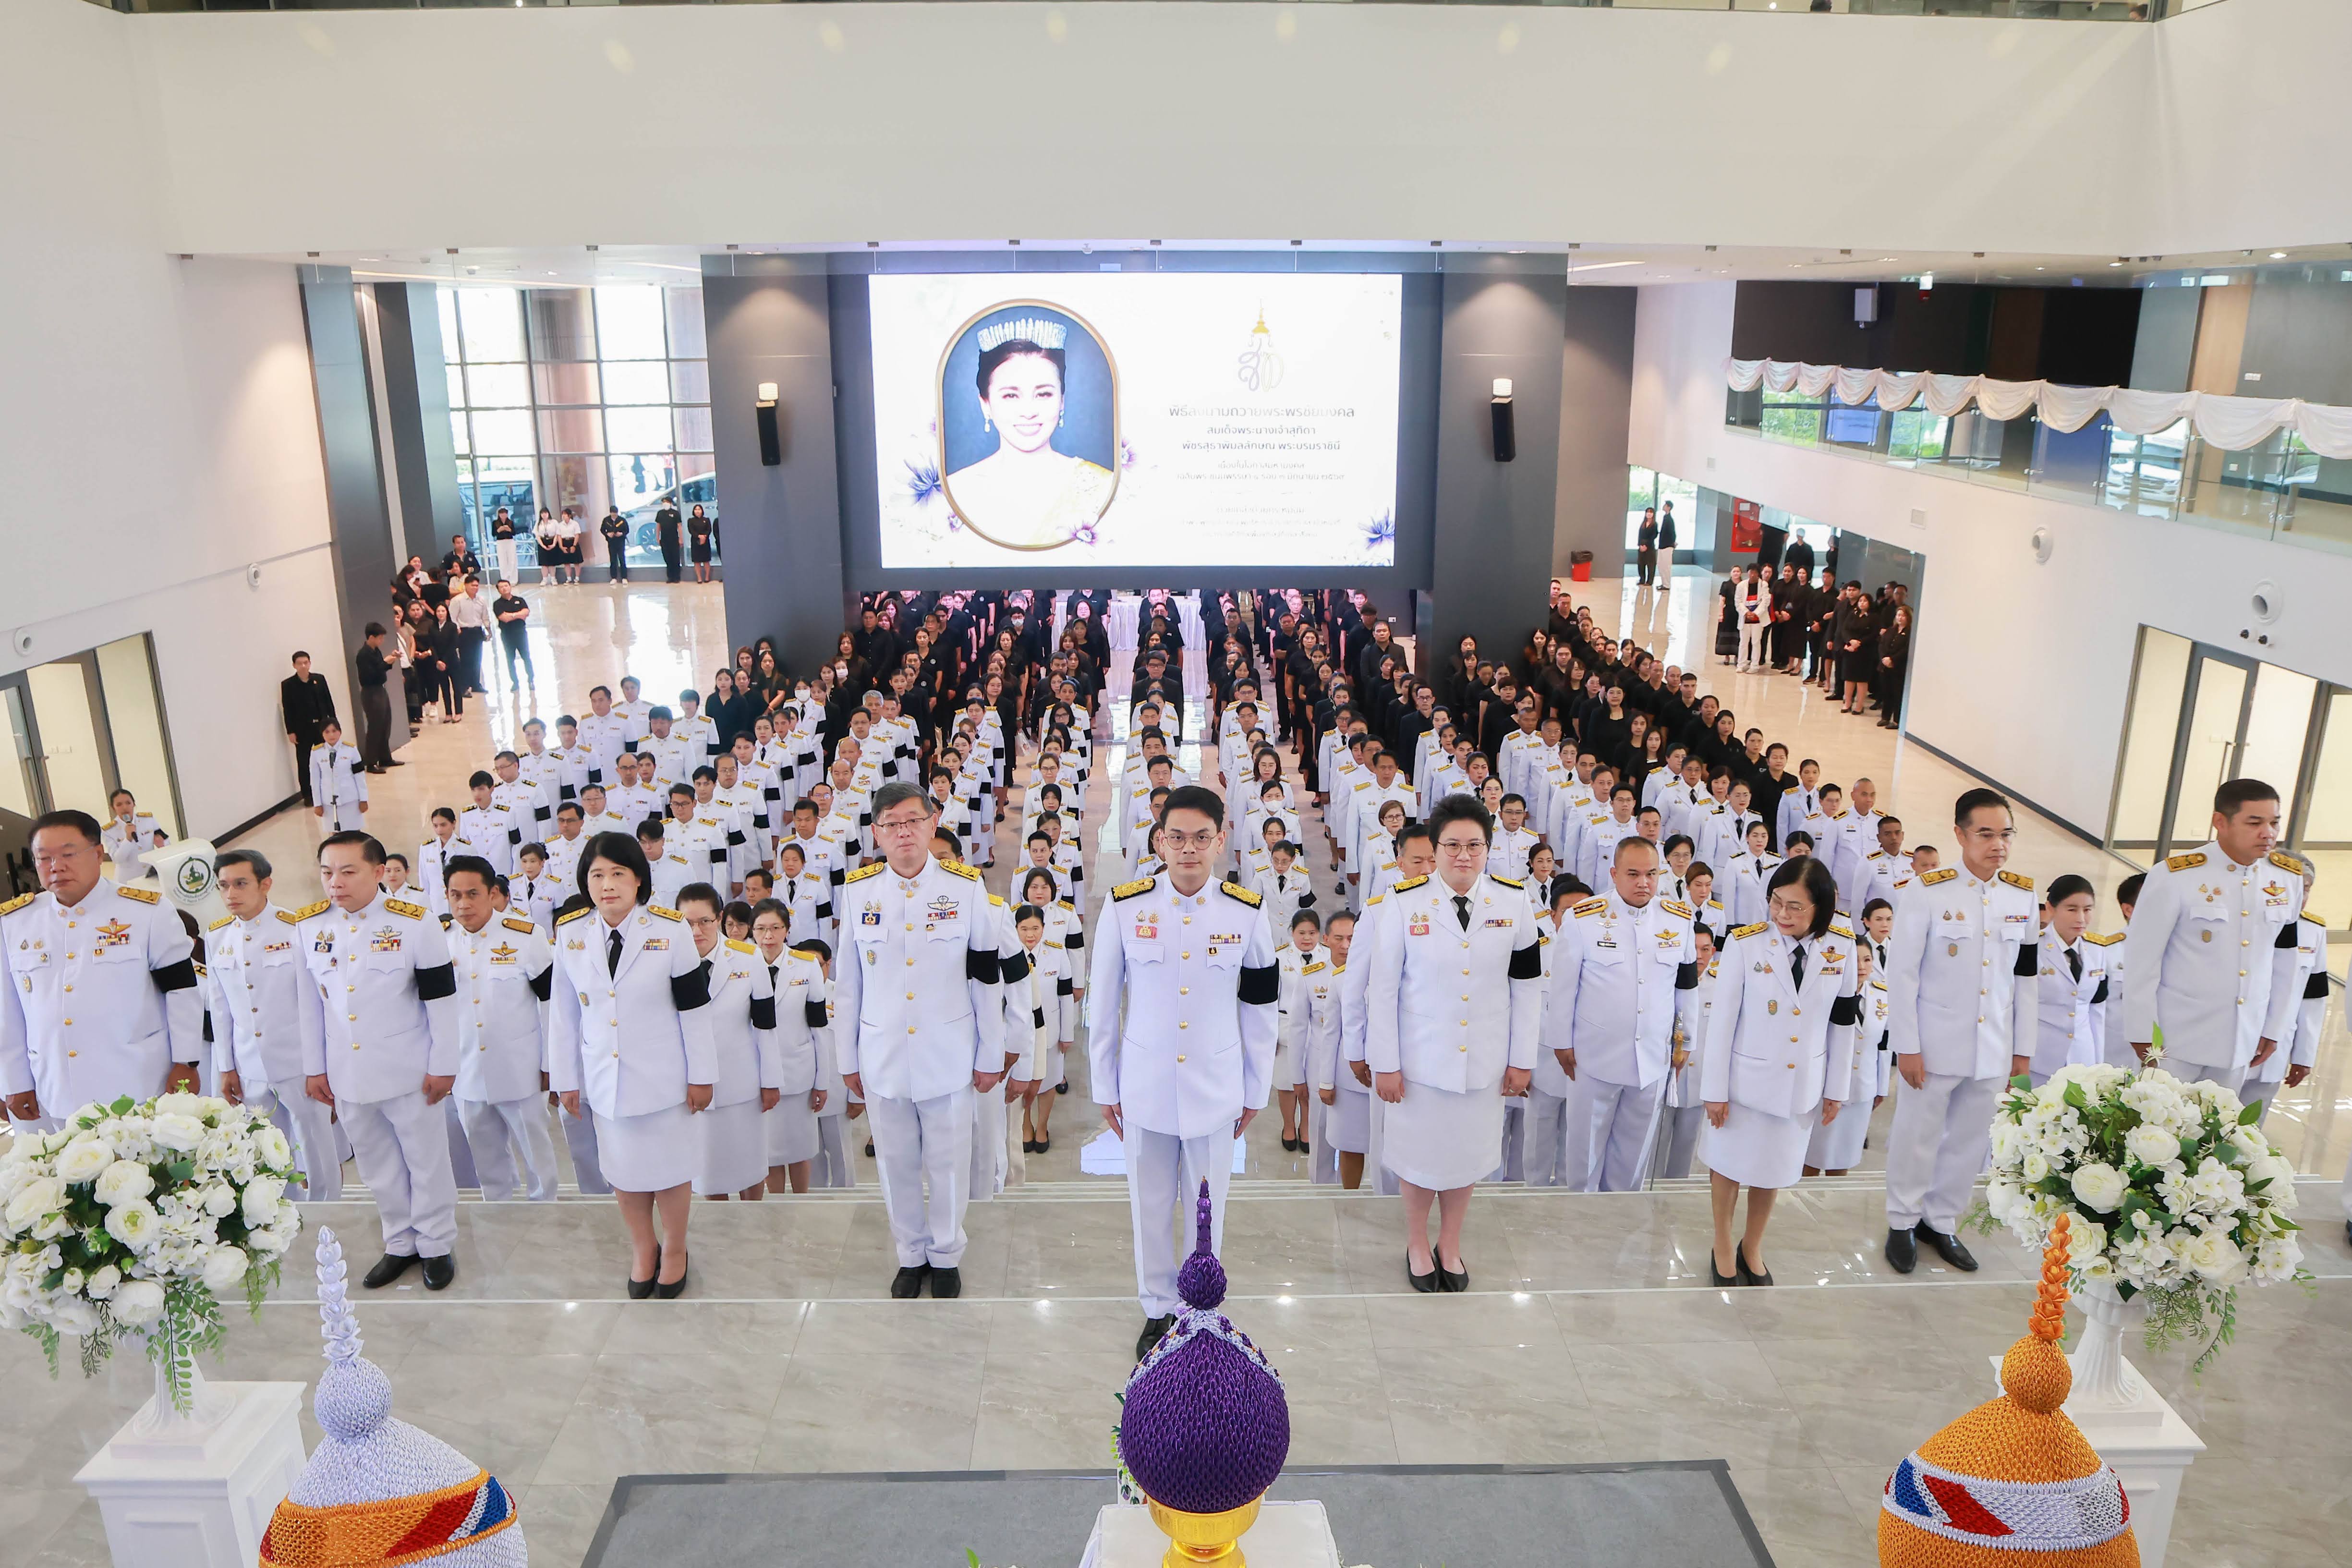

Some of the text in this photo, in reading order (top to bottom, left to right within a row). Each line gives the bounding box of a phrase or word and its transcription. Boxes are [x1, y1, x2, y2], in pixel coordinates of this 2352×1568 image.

[1207, 424, 1316, 437] สมเด็จพระนางเจ้าสุทิดา
[1182, 438, 1341, 452] พัชรสุธาพิมลลักษณ พระบรมราชินี
